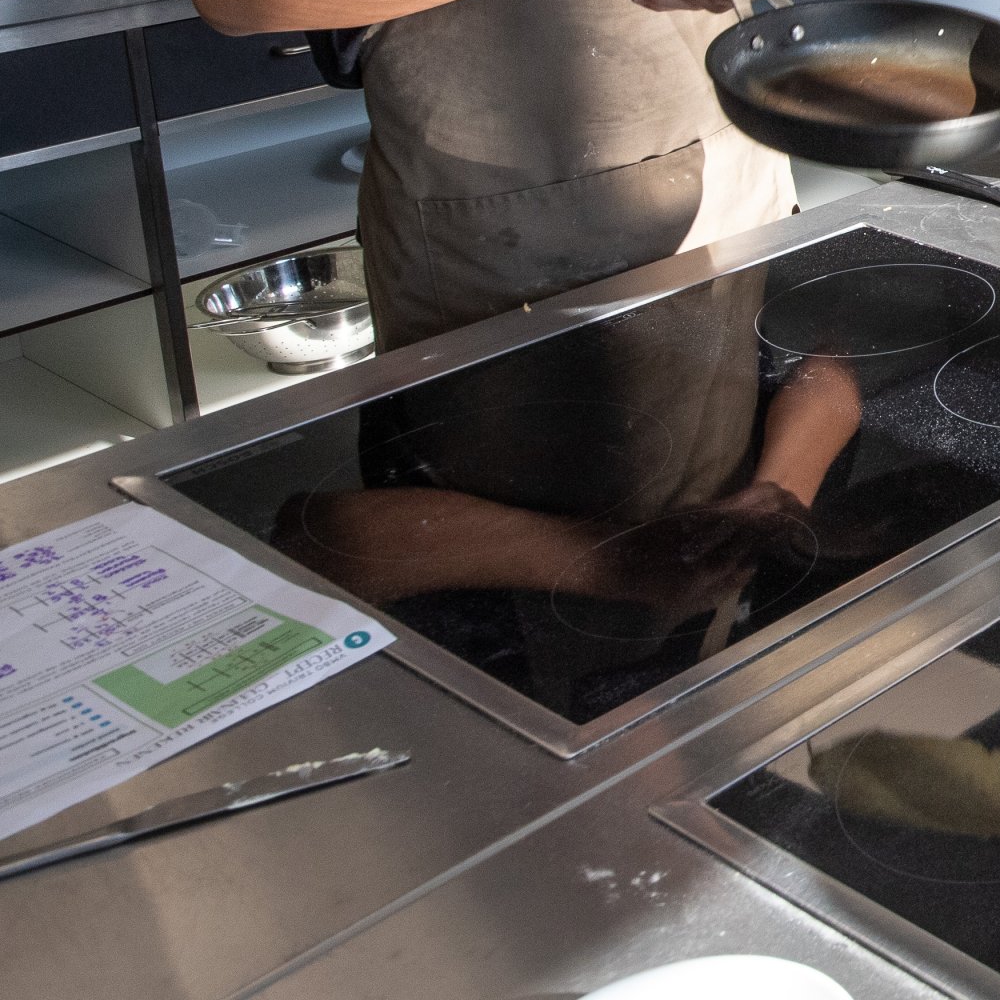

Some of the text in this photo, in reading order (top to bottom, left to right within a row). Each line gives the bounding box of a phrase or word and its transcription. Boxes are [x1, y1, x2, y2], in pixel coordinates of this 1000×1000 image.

[284, 643, 343, 679] RECEPT
[199, 680, 270, 726] CULINAIR
[210, 652, 348, 724] VMBO TRIVIUM COLLEGE
[115, 723, 195, 768] REKENEN
